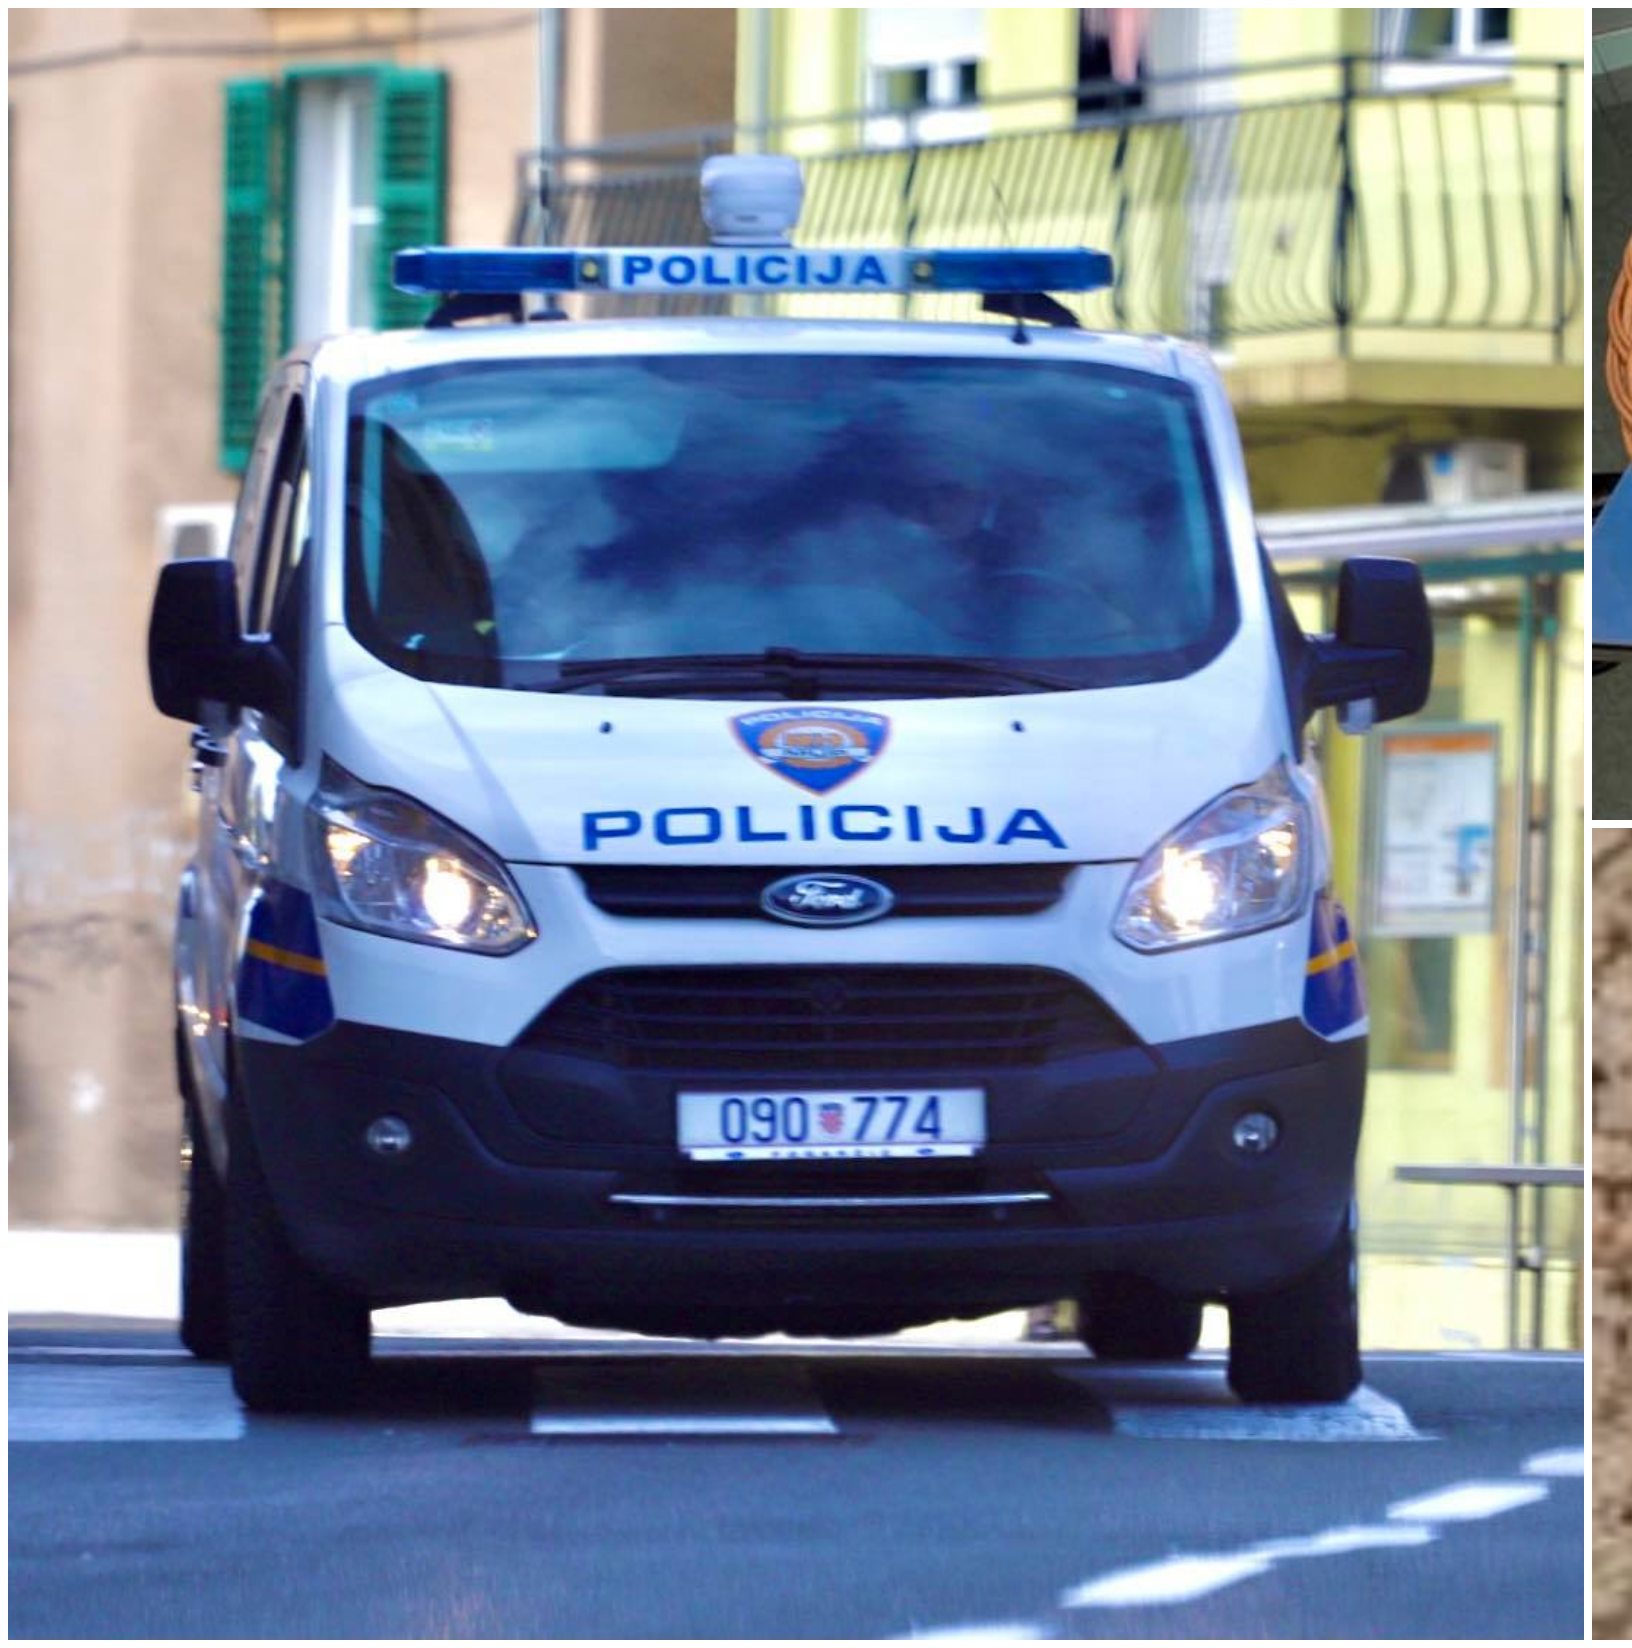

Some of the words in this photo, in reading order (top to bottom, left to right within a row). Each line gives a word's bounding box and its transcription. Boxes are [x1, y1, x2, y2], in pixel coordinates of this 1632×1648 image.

[622, 254, 888, 287] POLICIJA
[582, 804, 1069, 852] POLICIJA
[788, 880, 865, 910] Ford
[720, 1097, 809, 1144] 090
[852, 1095, 942, 1140] 774
